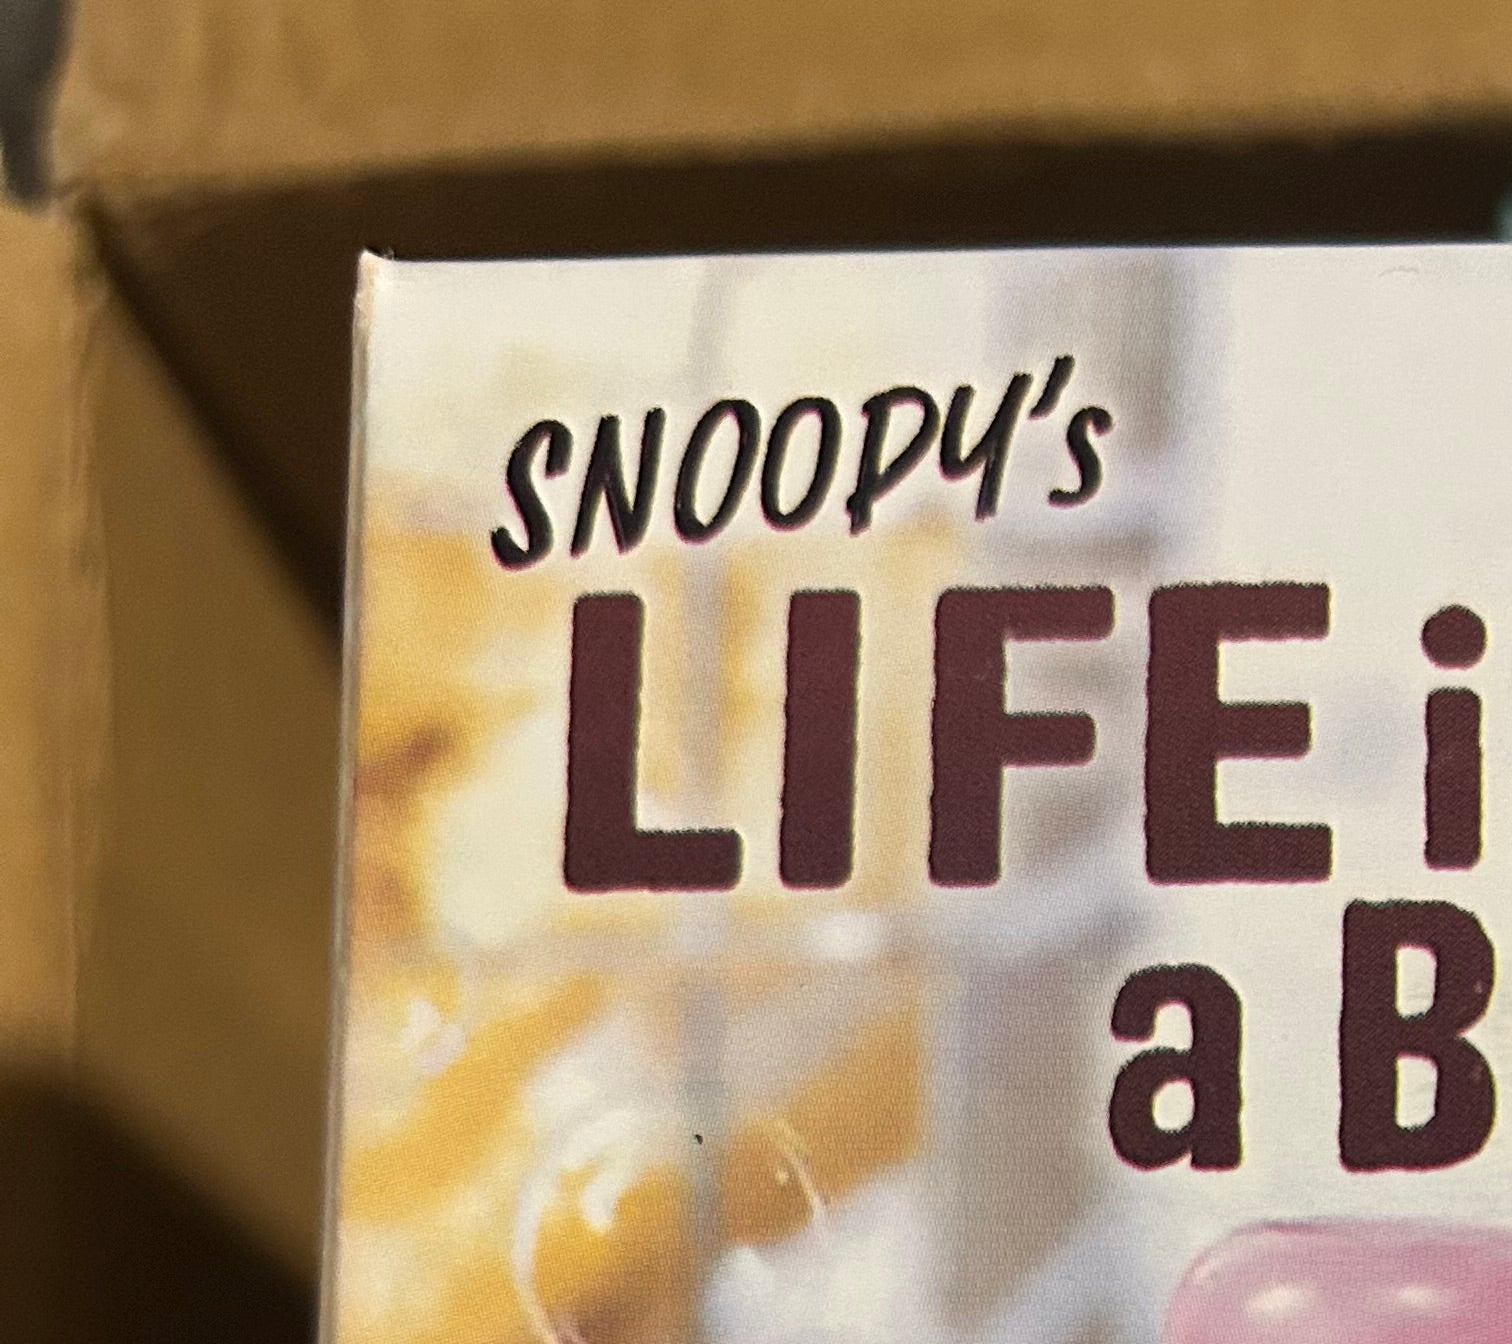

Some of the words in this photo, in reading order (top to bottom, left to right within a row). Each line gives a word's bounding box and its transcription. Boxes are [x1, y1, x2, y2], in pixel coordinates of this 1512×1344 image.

[488, 355, 1114, 570] SNOOPY's
[562, 581, 1334, 895] LIFE
[1107, 961, 1245, 1174] a
